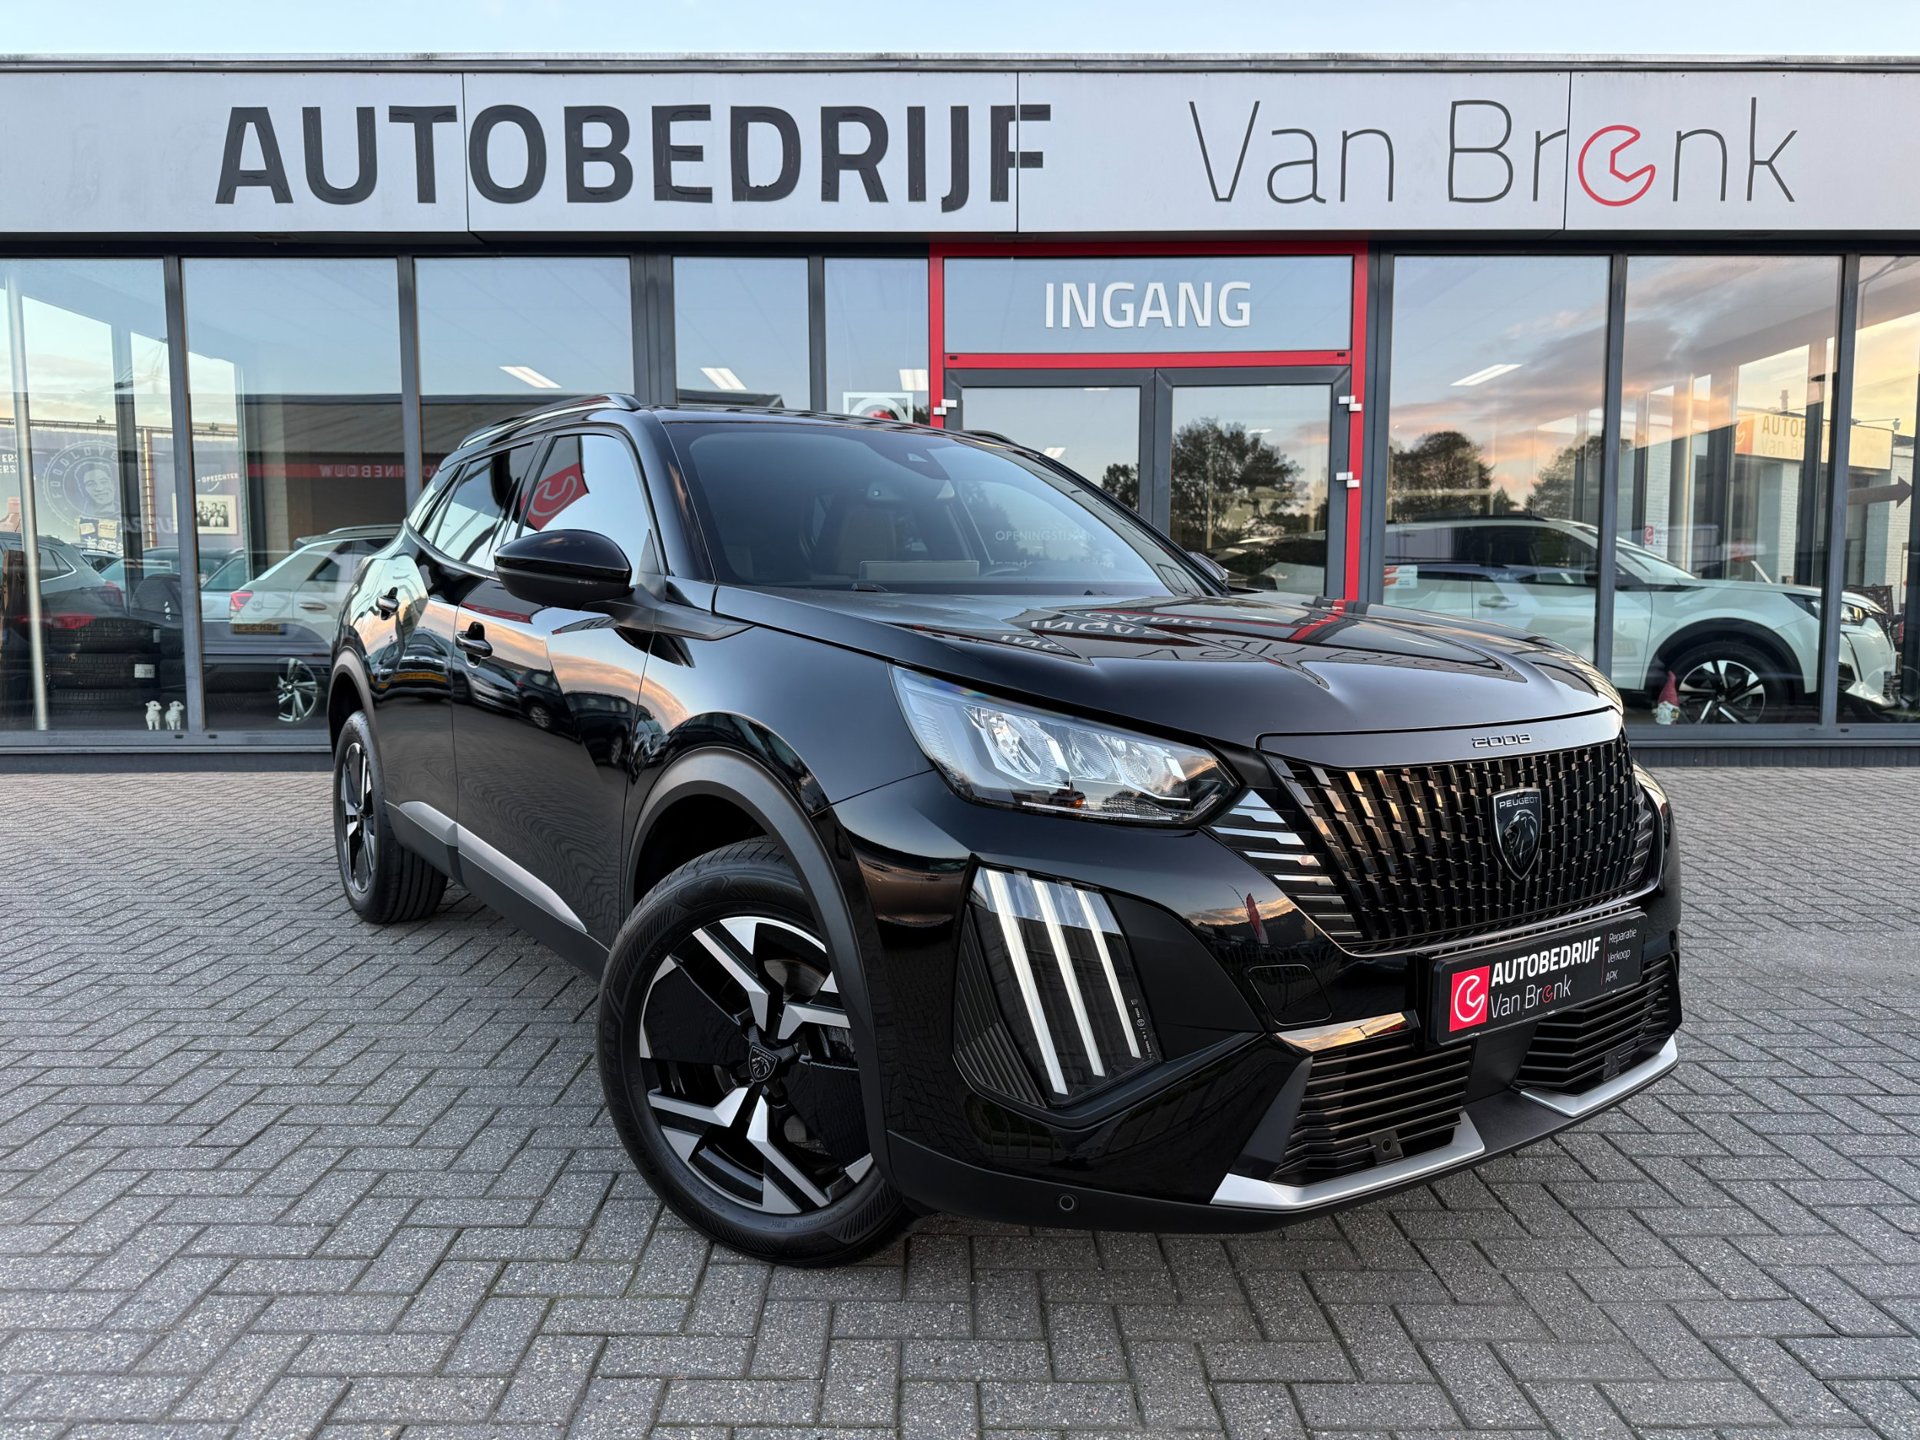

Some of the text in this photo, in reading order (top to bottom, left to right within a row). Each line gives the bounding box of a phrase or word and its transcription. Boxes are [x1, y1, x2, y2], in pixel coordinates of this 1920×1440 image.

[215, 103, 1051, 213] AUTOBEDRIJF
[1188, 100, 1395, 205] Van
[1045, 280, 1251, 329] INGANG
[1472, 733, 1533, 748] 2008
[1499, 796, 1539, 809] PEUGEOT
[1608, 927, 1637, 944] Reparatie
[1490, 936, 1601, 988] AUTOBEDRIJF
[1607, 948, 1631, 964] Verkoop
[1605, 969, 1619, 984] APK
[1490, 992, 1521, 1019] Van
